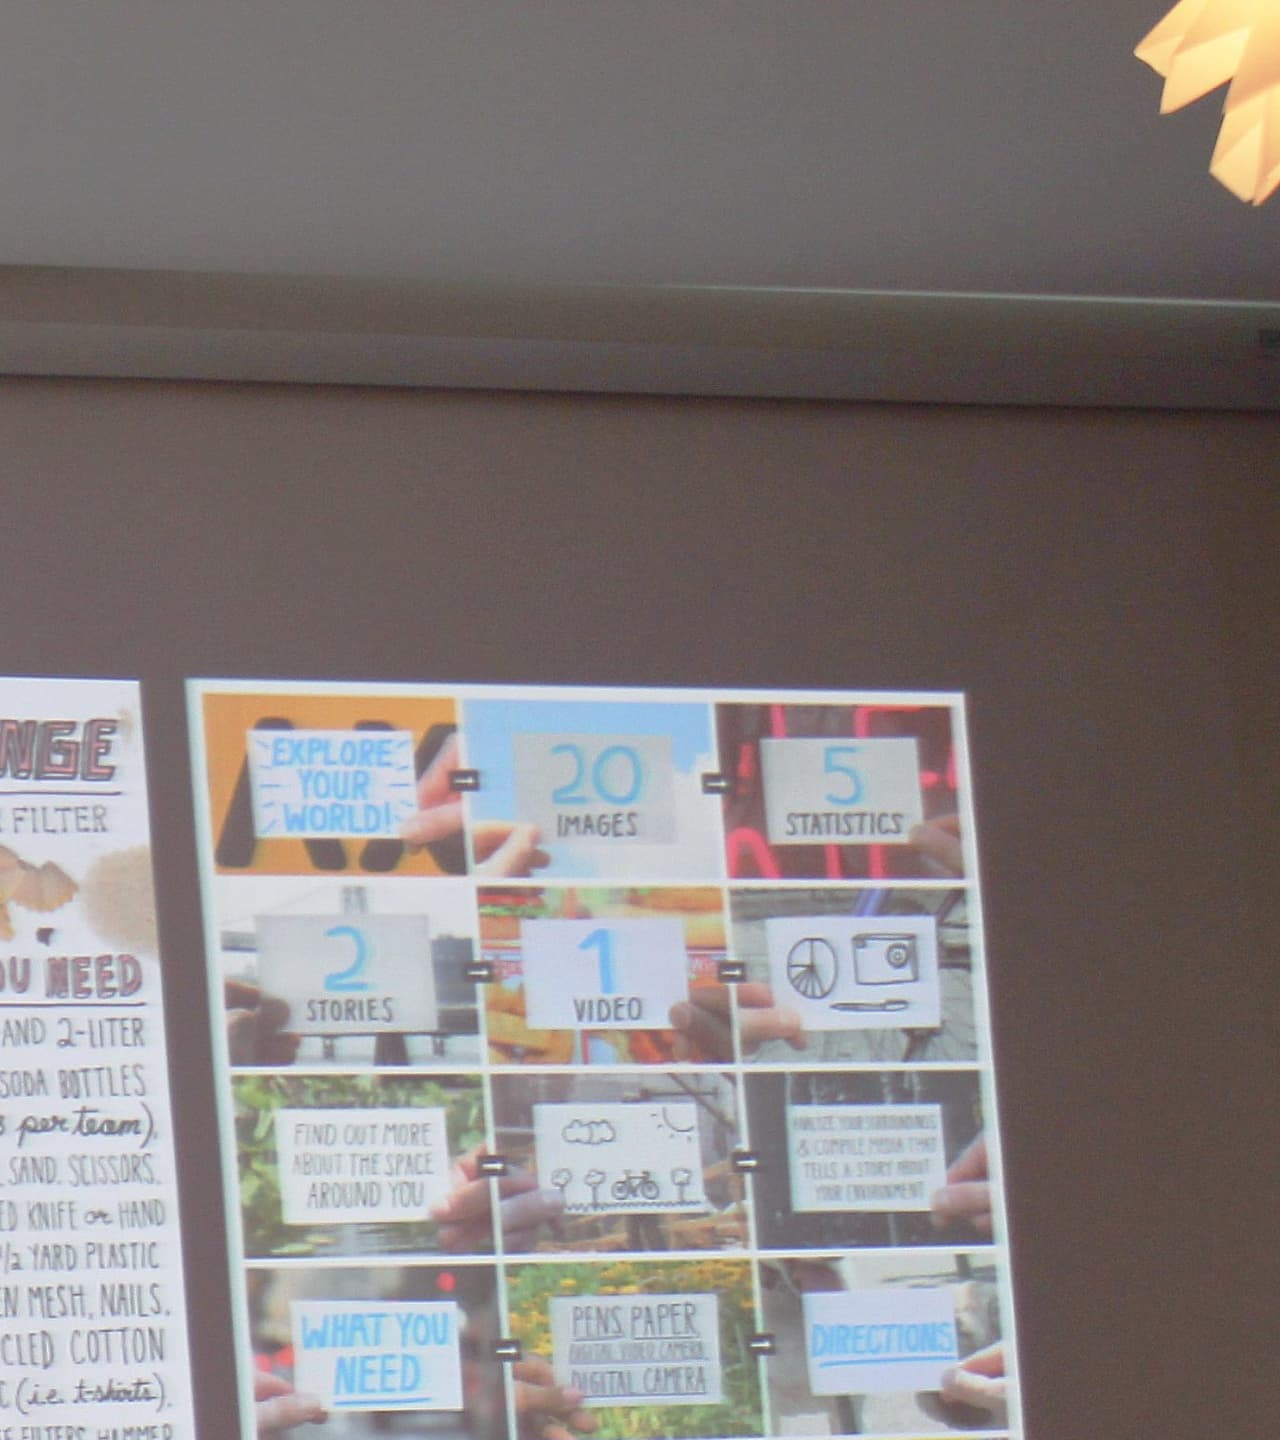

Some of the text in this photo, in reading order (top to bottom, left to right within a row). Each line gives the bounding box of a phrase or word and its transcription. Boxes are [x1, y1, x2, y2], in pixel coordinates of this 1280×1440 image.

[272, 739, 393, 768] EXPLORE
[297, 771, 370, 800] YOUR
[552, 744, 645, 805] 20
[823, 746, 864, 806] 5
[12, 805, 108, 834] FILTER
[283, 803, 392, 834] WORLD!
[558, 812, 639, 838] IMAGES
[785, 812, 903, 836] STATISTICS
[323, 925, 374, 993] 2
[578, 928, 618, 994] 1
[45, 954, 141, 999] NEED
[305, 997, 394, 1023] STORIES
[573, 998, 642, 1023] VIDEO
[56, 1016, 146, 1050] 2-LITER
[59, 1065, 147, 1098] BOTTLES
[16, 1115, 69, 1149] per
[294, 1122, 433, 1147] FIND MORE
[307, 1181, 425, 1209] AROUND YOU
[28, 1201, 77, 1231] KNIFE
[118, 1199, 166, 1230] HAND
[27, 1242, 160, 1271] YARD PLASTIC
[70, 1326, 165, 1365] COTTON
[301, 1311, 449, 1349] WHAT YOU
[812, 1322, 956, 1357] DIRECTIONS
[333, 1353, 423, 1395] NEED
